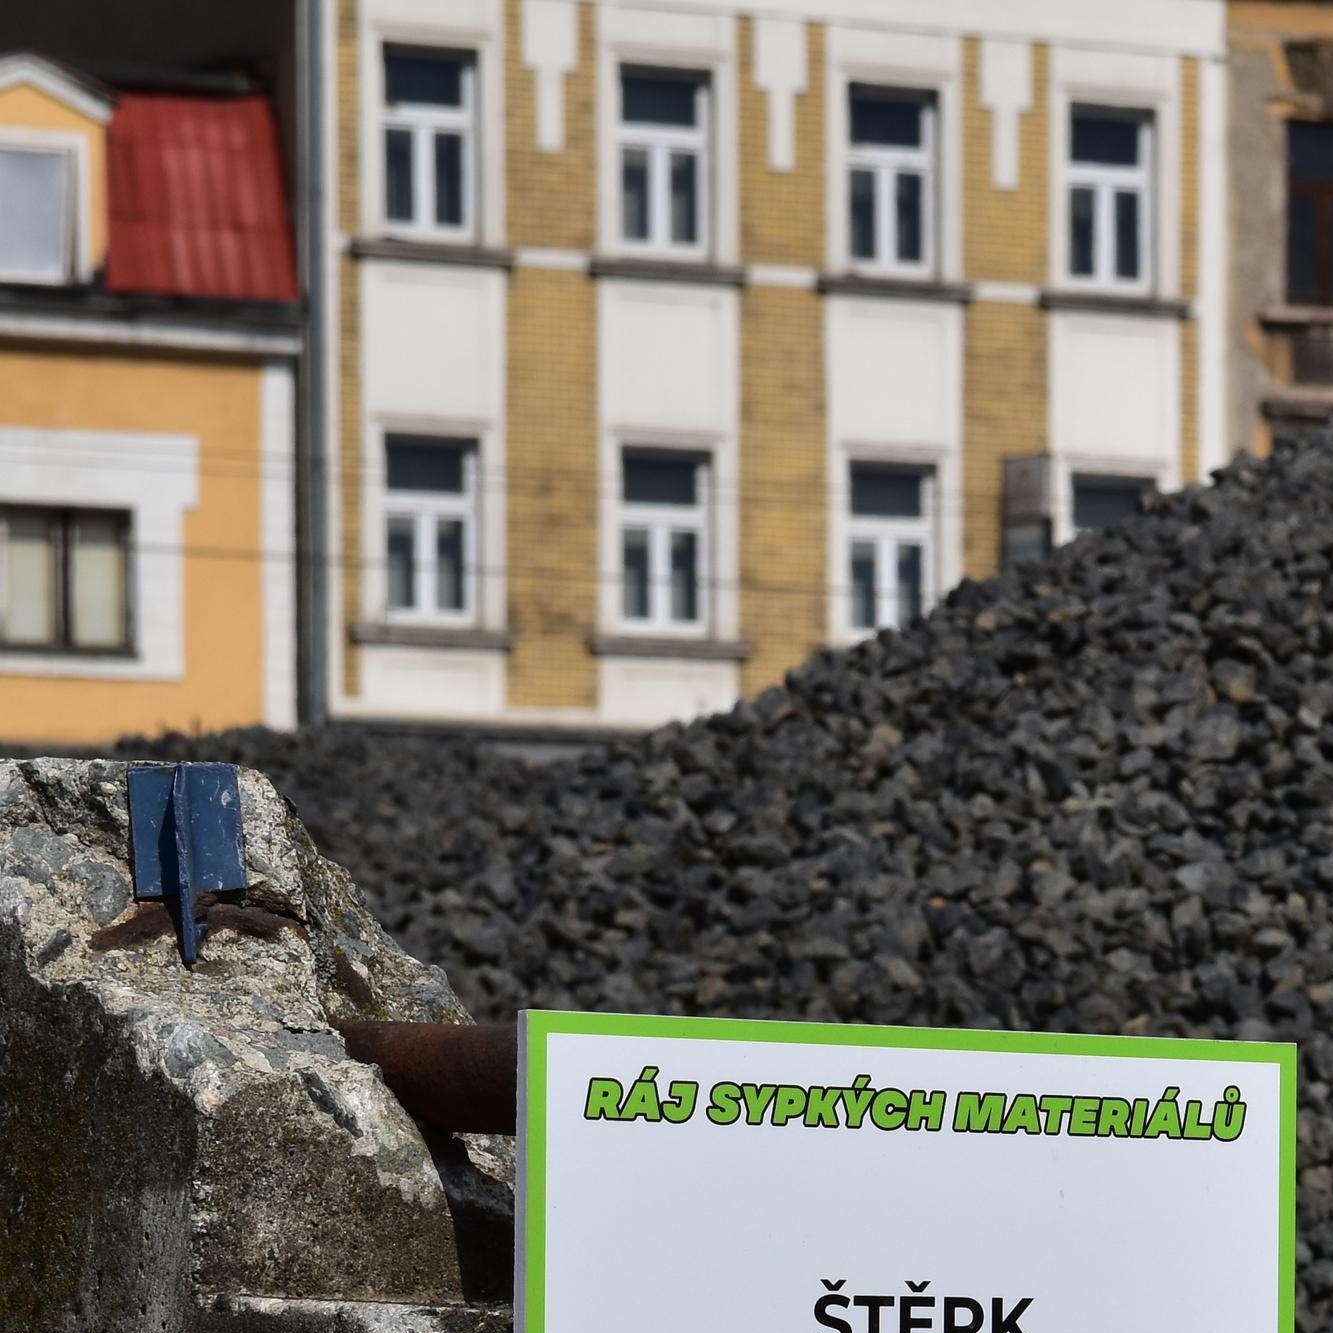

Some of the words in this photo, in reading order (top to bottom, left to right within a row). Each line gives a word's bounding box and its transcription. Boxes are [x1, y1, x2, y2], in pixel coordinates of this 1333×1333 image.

[584, 1066, 699, 1124] RÁJ
[706, 1074, 947, 1132] SYPKÝCH
[952, 1085, 1247, 1142] MATERIÁLŮ
